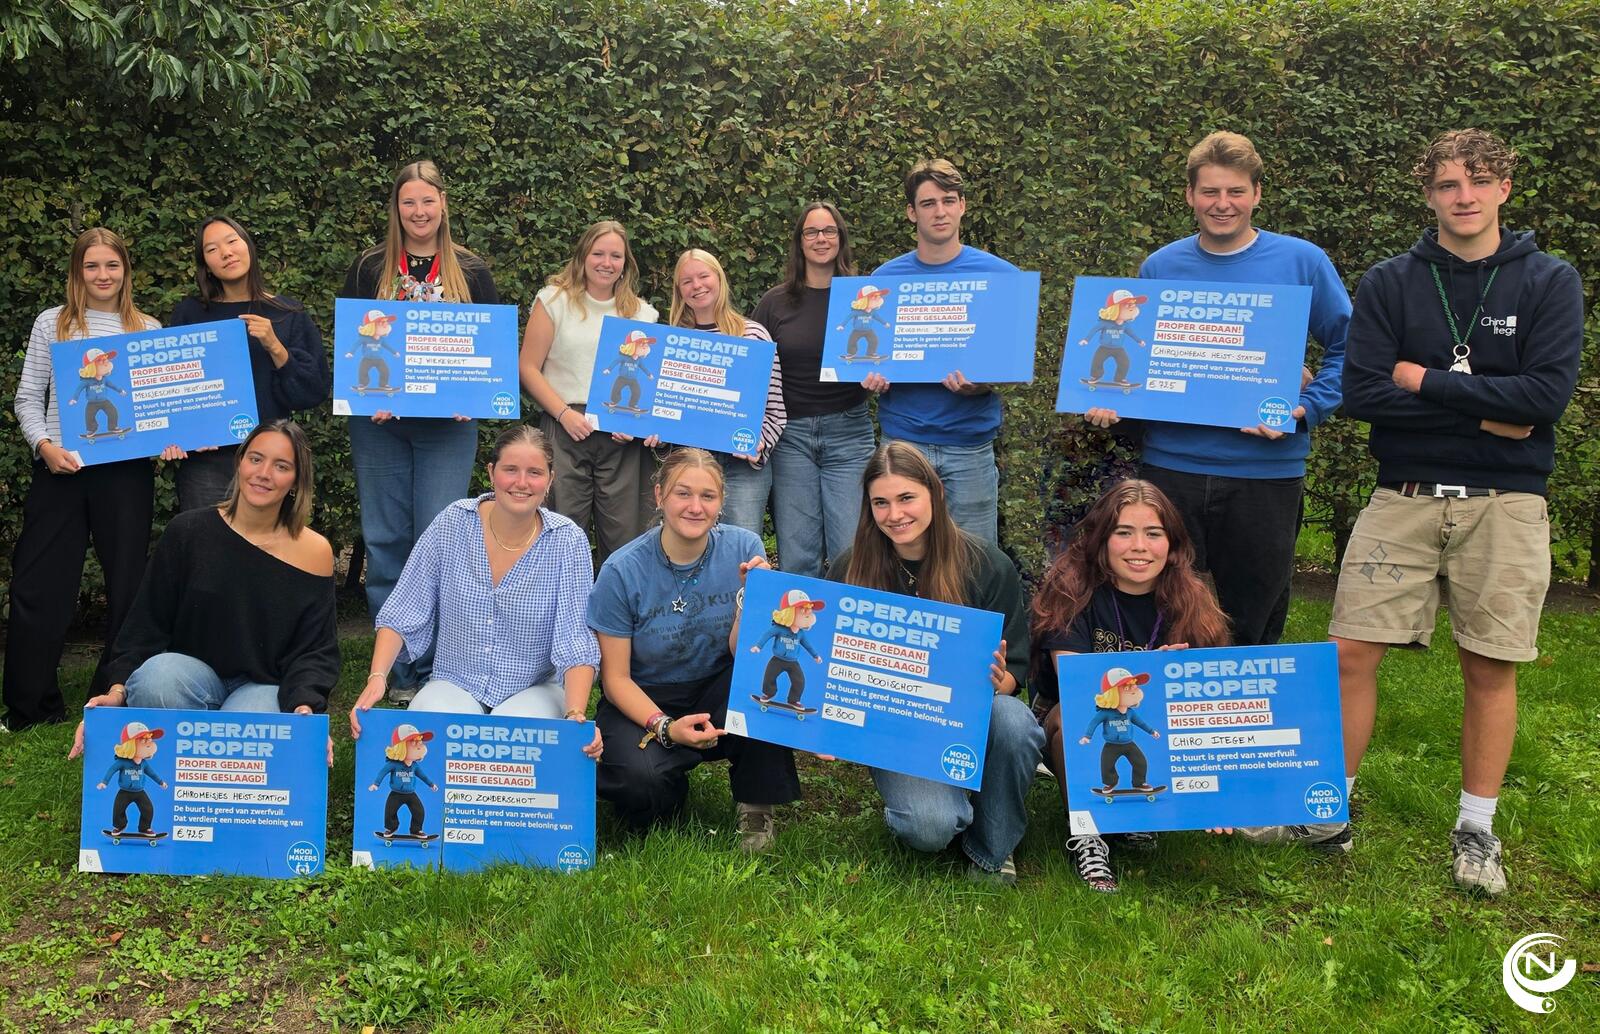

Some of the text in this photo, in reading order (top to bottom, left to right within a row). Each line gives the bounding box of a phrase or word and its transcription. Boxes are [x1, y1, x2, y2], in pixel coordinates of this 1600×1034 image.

[899, 280, 987, 292] OPERATIE
[898, 293, 973, 304] PROPER
[1159, 290, 1274, 306] OPERATIE
[406, 310, 491, 322] OPERATIE
[1157, 305, 1254, 321] PROPER
[1157, 321, 1241, 332] PROPER GEDAAN!
[1480, 316, 1506, 326] Chiro
[406, 322, 478, 334] PROPER
[126, 330, 218, 353] OPERATIE
[1156, 332, 1242, 344] MISSIE GESLAAGD!
[666, 334, 748, 356] OPERATIE
[128, 346, 206, 366] PROPER
[663, 346, 733, 367] PROPER
[131, 361, 199, 376] PROPER GEDAAN!
[663, 360, 724, 375] PROPER GEDAAN!
[1188, 363, 1208, 371] gered
[1224, 365, 1260, 373] zwerfvuil.
[132, 370, 202, 386] MISSIE GESLAAGD!
[661, 369, 724, 384] MISSIE GESLAAGD!
[1231, 374, 1262, 383] beloning
[659, 381, 674, 389] KLJ
[1158, 380, 1176, 389] 725
[1260, 407, 1289, 415] MAKERS
[838, 596, 961, 633] OPERATIE
[836, 615, 940, 648] PROPER
[836, 635, 926, 660] PROPER GEDAAN!
[833, 648, 926, 674] MISSIE GESLAAGD!
[1164, 657, 1295, 678] OPERATIE
[1165, 678, 1277, 698] PROPER
[826, 682, 836, 690] De
[837, 684, 859, 695] buurt
[868, 690, 889, 703] gered
[890, 696, 904, 705] van
[907, 698, 945, 713] zwerfvuil.
[824, 692, 962, 728] Dat verdient een mooie beloning van
[824, 705, 855, 721] € 800
[1169, 700, 1266, 713] PROPER GEDAAN!
[1170, 714, 1270, 727] MISSIE GESLAAGD!
[177, 722, 291, 739] OPERATIE
[447, 725, 558, 743] OPERATIE
[1211, 734, 1255, 745] ITEGEM
[176, 740, 273, 756] PROPER
[446, 742, 541, 760] PROPER
[949, 750, 970, 760] MOOI
[1182, 753, 1206, 761] buurt
[1216, 752, 1238, 762] gered
[1257, 749, 1297, 758] zwerfvuil.
[178, 759, 262, 769] PROPER GEDAAN!
[448, 761, 531, 773] PROPER GEDAAN!
[943, 756, 975, 769] MAKERS
[1188, 763, 1221, 772] verdient
[1267, 760, 1301, 769] beloning
[177, 772, 264, 782] MISSIE GESLAAGD!
[448, 774, 533, 786] MISSIE GESLAAGD!
[1175, 779, 1209, 789] € 600
[1307, 796, 1339, 804] MAKERS
[214, 806, 233, 815] gered
[484, 809, 503, 818] gered
[520, 810, 554, 819] zwerfvuil.
[258, 818, 287, 826] beloning
[527, 821, 556, 830] beloning
[176, 828, 205, 839] € 725
